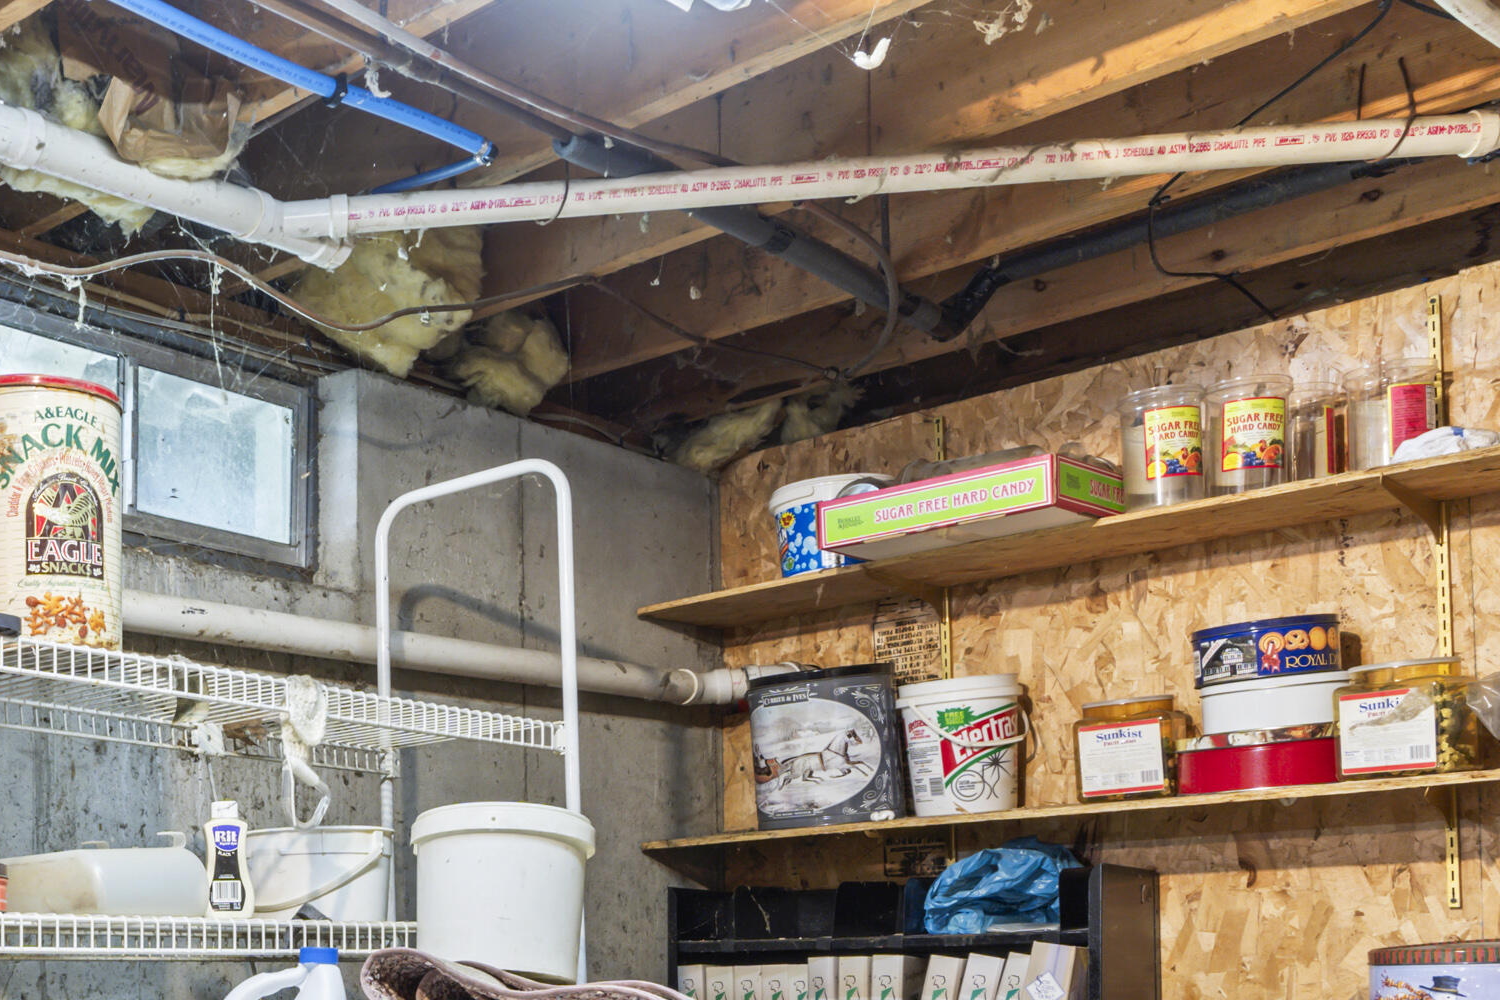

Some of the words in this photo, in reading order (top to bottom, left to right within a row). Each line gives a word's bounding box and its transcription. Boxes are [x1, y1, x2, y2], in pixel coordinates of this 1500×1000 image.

[1123, 146, 1154, 158] SCHEDULE
[1168, 143, 1186, 155] ASTM
[1214, 138, 1249, 151] CHARLOTTE
[1253, 137, 1266, 148] PIPE
[648, 184, 678, 195] SCHEDULE
[692, 182, 707, 192] ASTM
[733, 177, 767, 190] CHARLOTTE
[770, 175, 782, 186] PIPE
[34, 405, 98, 428] A&EAGLE
[1227, 412, 1260, 428] SUGAR
[1264, 412, 1284, 424] FREE
[1230, 423, 1254, 434] HARD
[1257, 421, 1281, 432] CANDY
[1153, 431, 1176, 441] ARD
[90, 436, 120, 498] MIX
[1090, 479, 1111, 501] SUGAR
[875, 503, 915, 523] SUGAR
[918, 497, 950, 516] FREE
[952, 490, 989, 509] HARD
[992, 478, 1036, 501] CANDY
[27, 539, 103, 567] EAGLE
[41, 561, 94, 576] SNACKS
[1285, 654, 1328, 669] ROYAL
[792, 693, 808, 702] IVES
[1096, 728, 1143, 743] Sunkist
[214, 830, 238, 843] Rit
